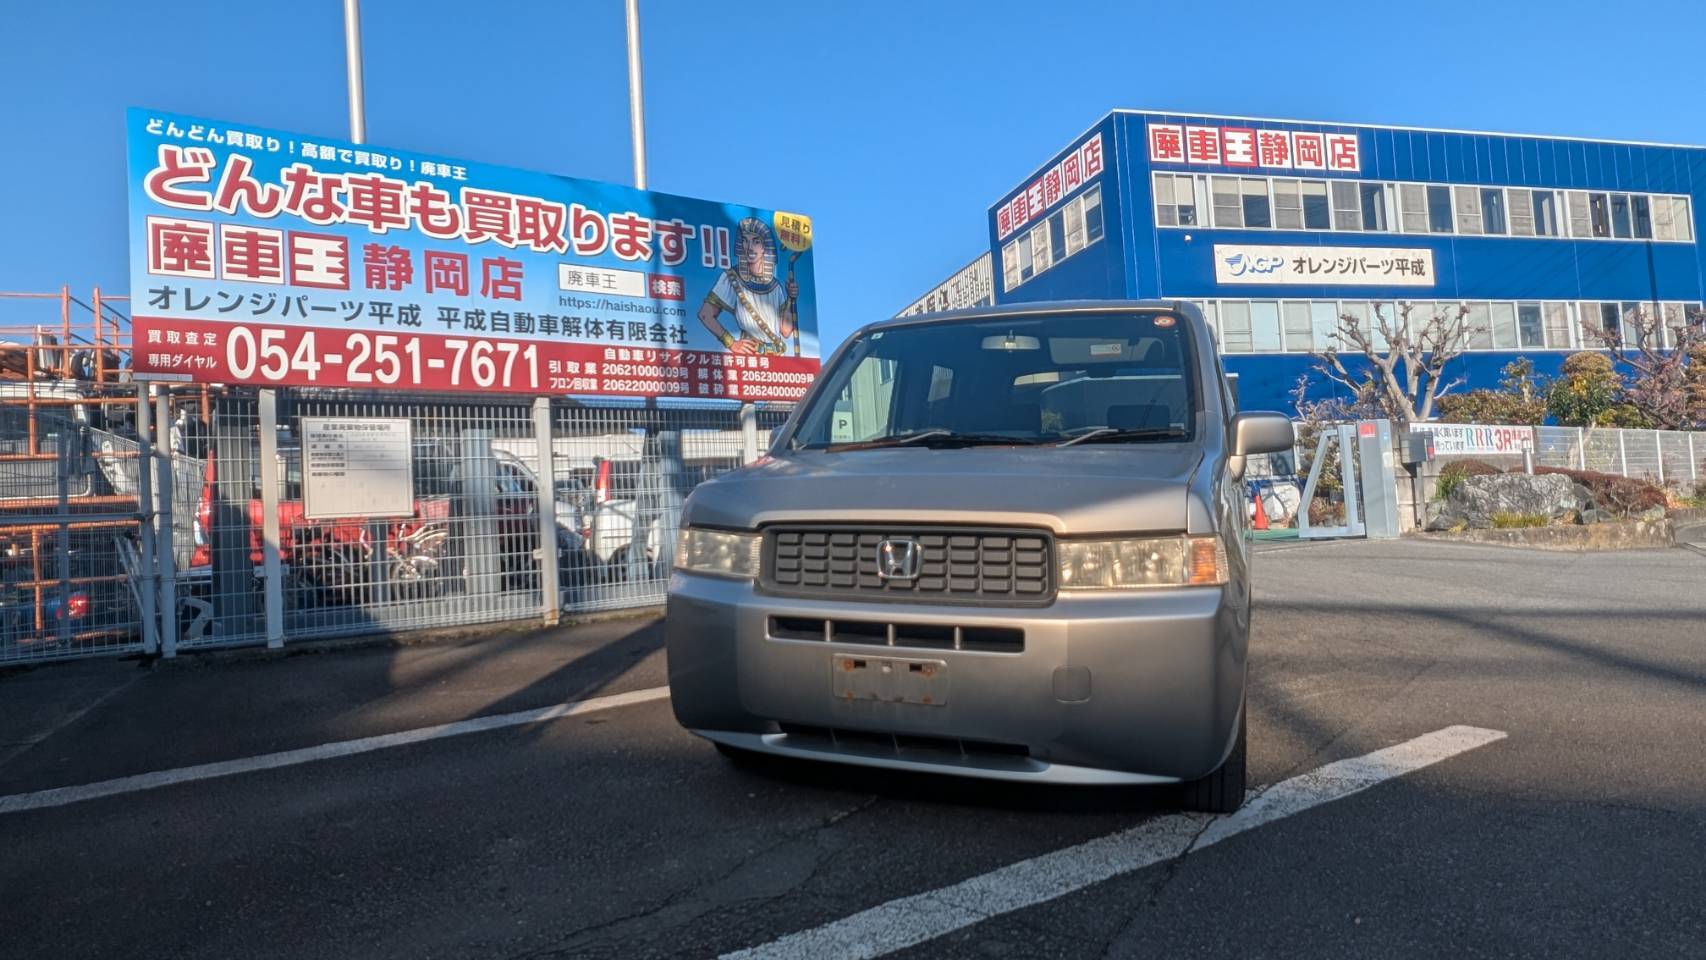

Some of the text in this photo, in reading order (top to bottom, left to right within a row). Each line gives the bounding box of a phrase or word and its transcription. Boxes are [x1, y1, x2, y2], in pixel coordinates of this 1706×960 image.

[362, 243, 525, 301] 静岡店
[1292, 257, 1425, 276] オレンジパーツ平成
[568, 270, 617, 289] 廃車王
[652, 279, 681, 296] 検索
[148, 285, 688, 344] オレンジパーツ平成 平成自動車解体有限会社
[559, 296, 686, 316] https://haishaou.com
[147, 329, 217, 346] 買取査定
[147, 353, 217, 369] 専用ダイヤル
[226, 326, 539, 389] 054-251-7671
[604, 348, 770, 369] 自動車リサイクル法許可番号
[839, 419, 848, 429] P
